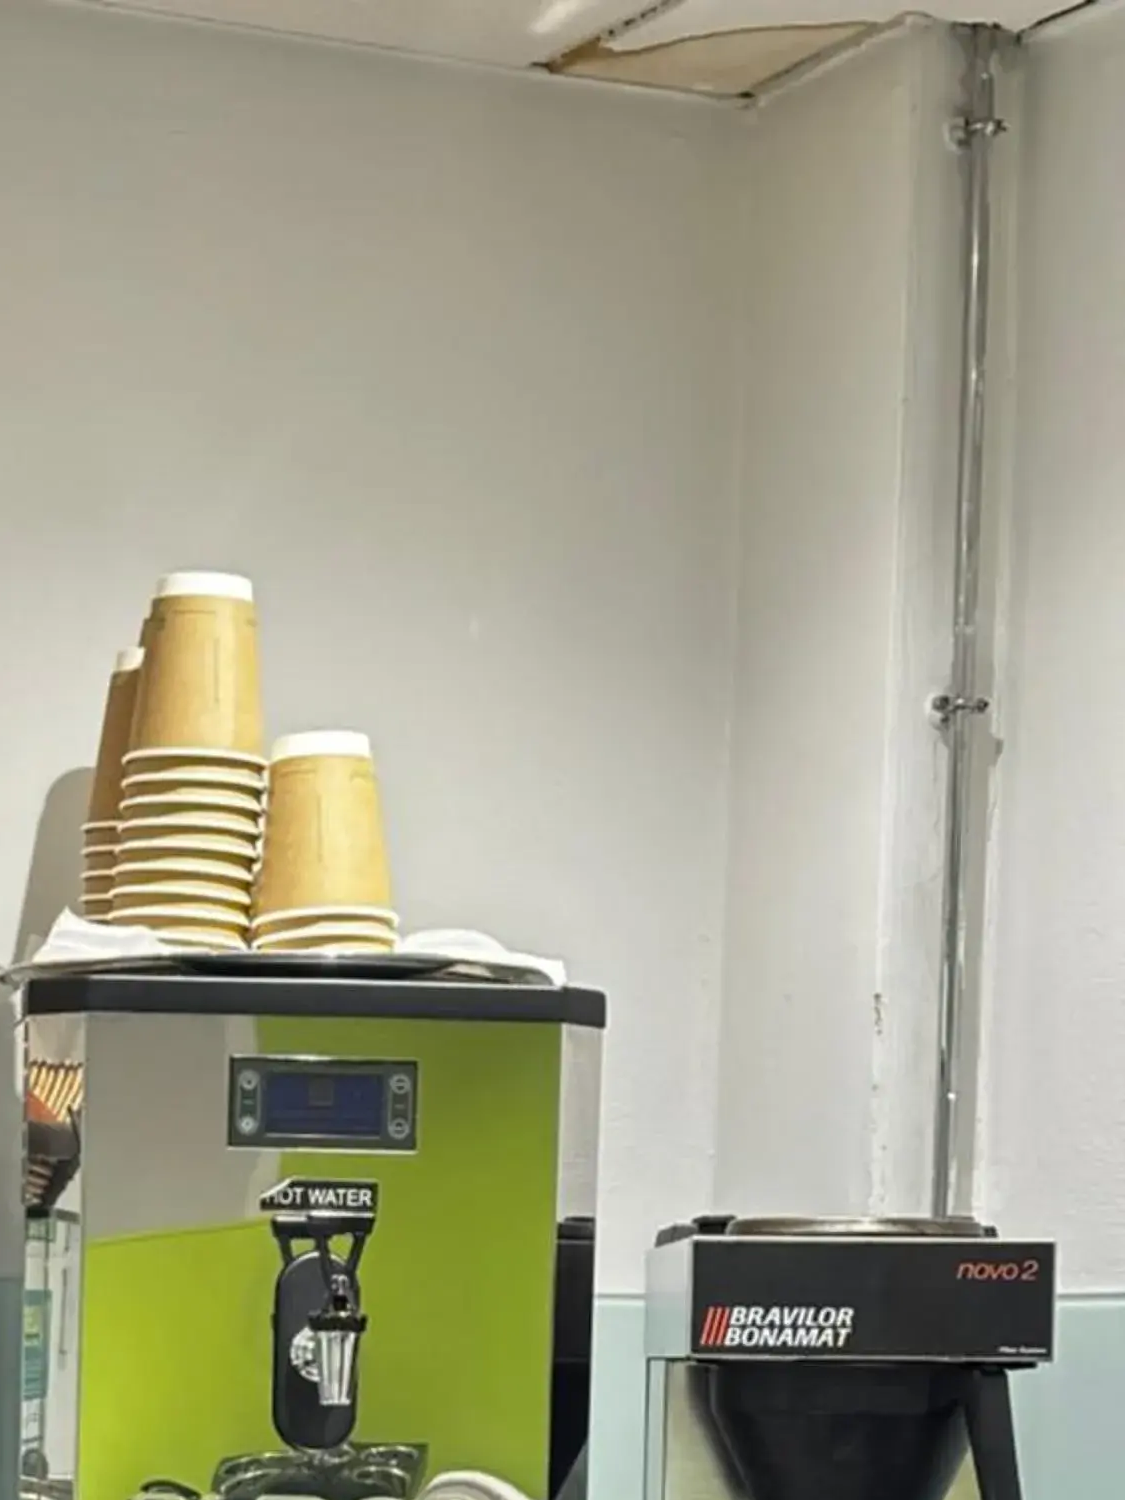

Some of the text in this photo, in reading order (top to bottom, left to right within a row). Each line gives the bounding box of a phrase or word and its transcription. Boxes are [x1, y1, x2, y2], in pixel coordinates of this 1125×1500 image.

[307, 1188, 373, 1207] WATER
[956, 1259, 1039, 1280] novo 2
[729, 1306, 854, 1326] BRAVILOR
[724, 1327, 852, 1347] BONAMAT
